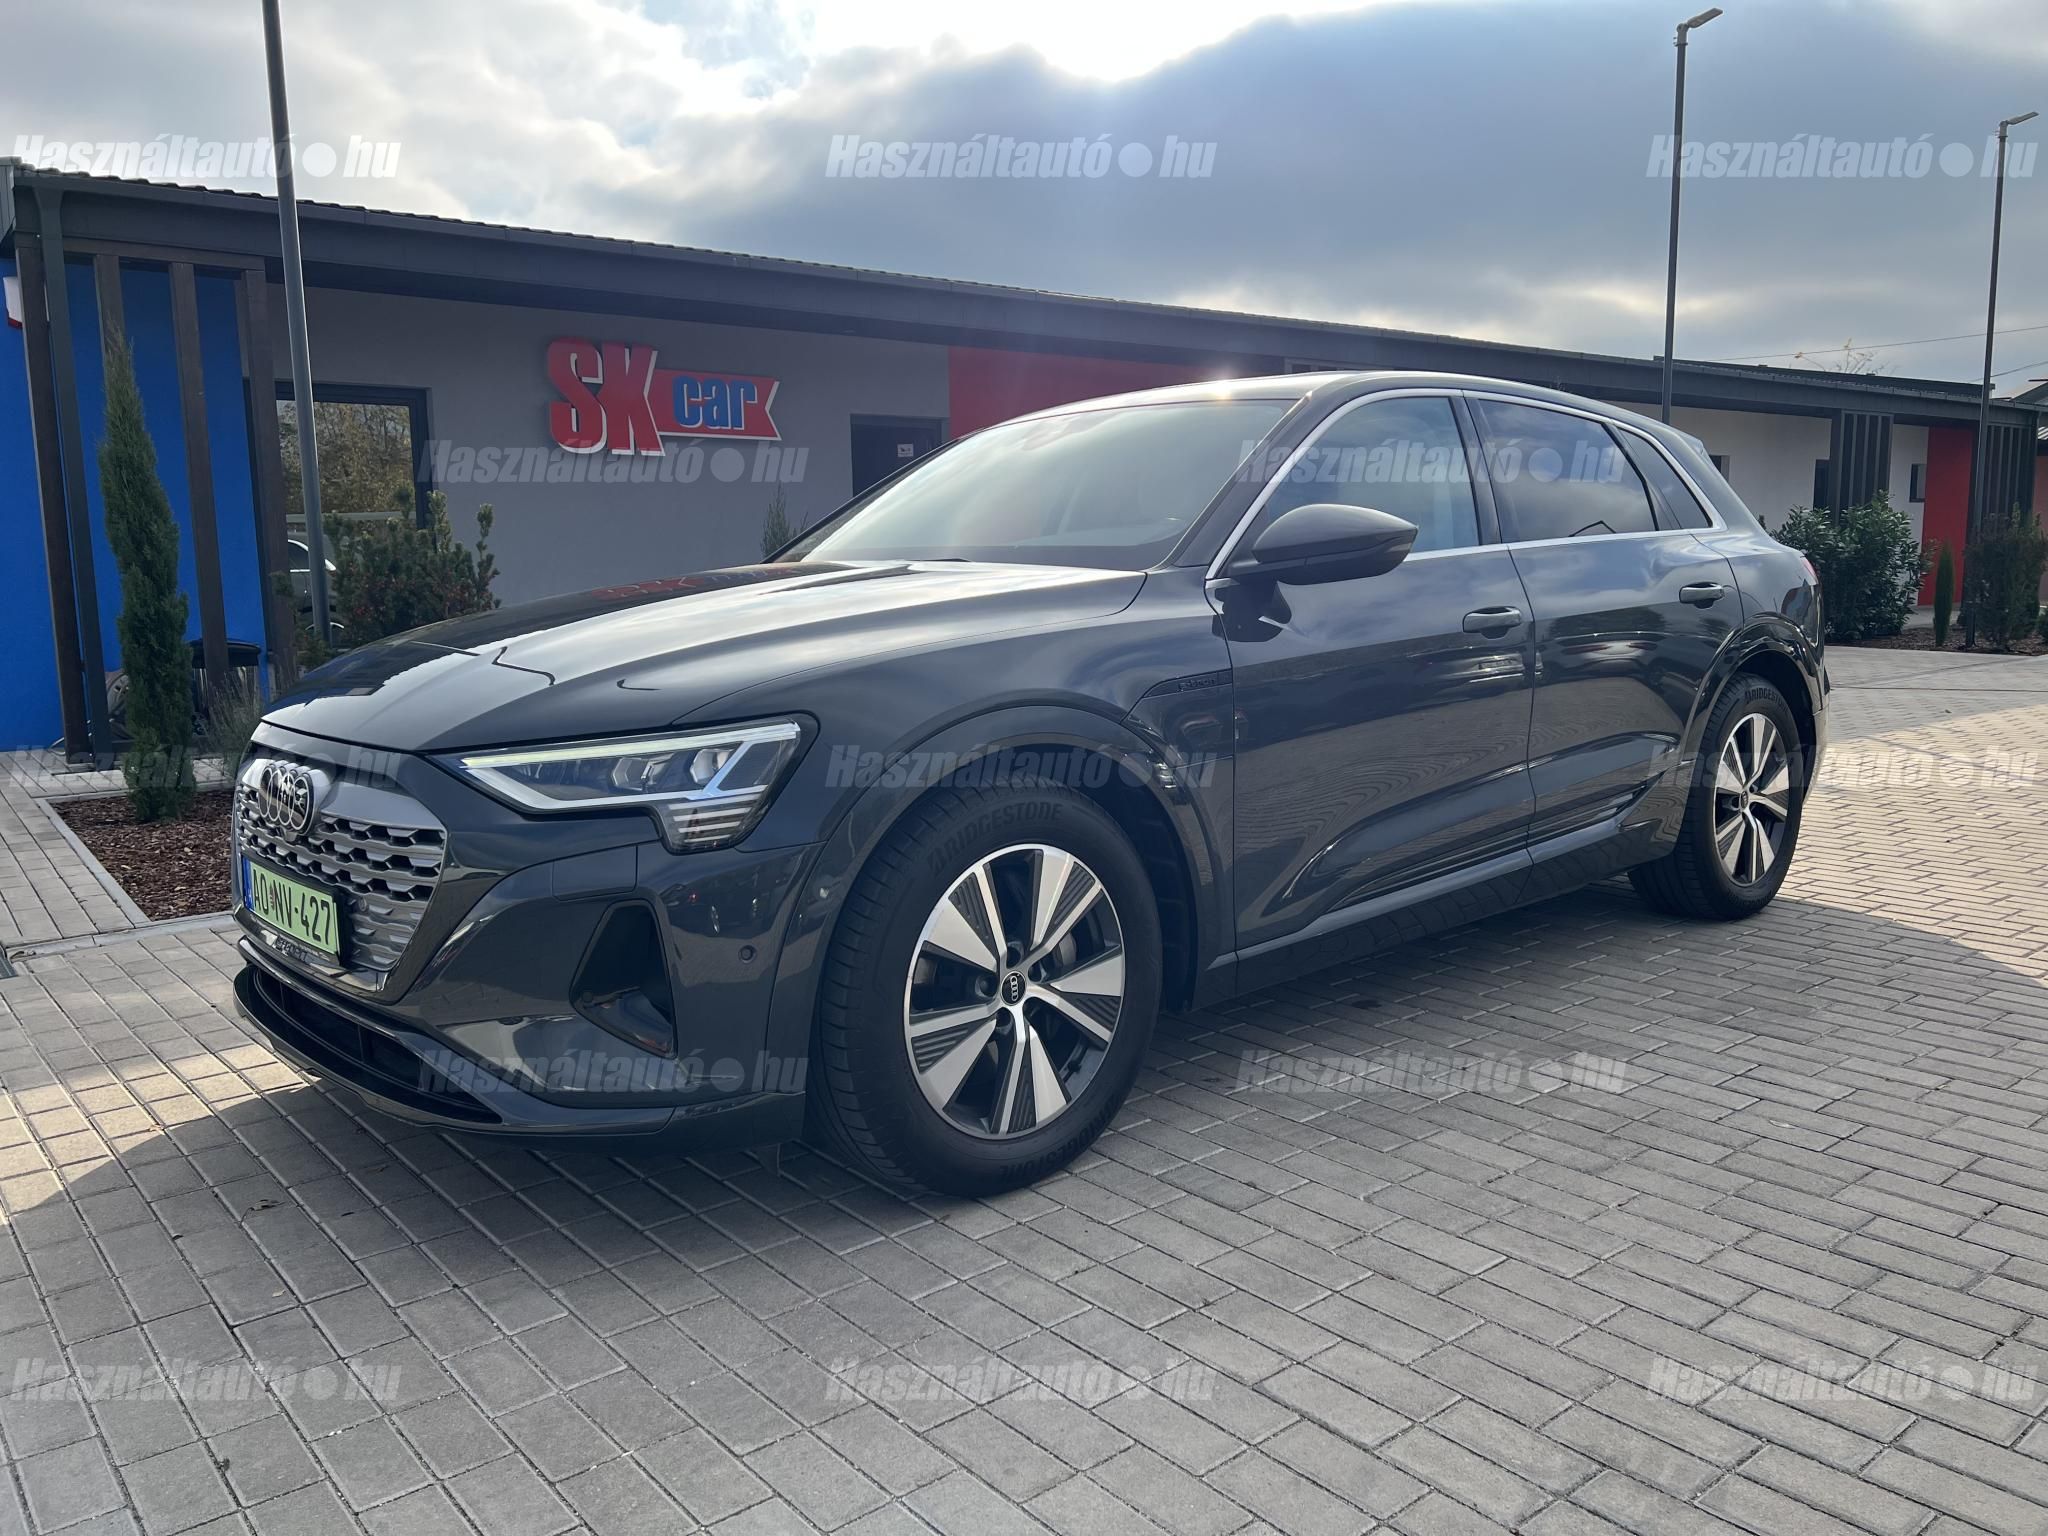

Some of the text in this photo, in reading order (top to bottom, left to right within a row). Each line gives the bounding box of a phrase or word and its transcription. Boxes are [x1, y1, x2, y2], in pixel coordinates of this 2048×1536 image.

[548, 337, 758, 457] SK car
[927, 801, 1064, 876] BRIDGESTONE
[273, 879, 330, 946] NV-427
